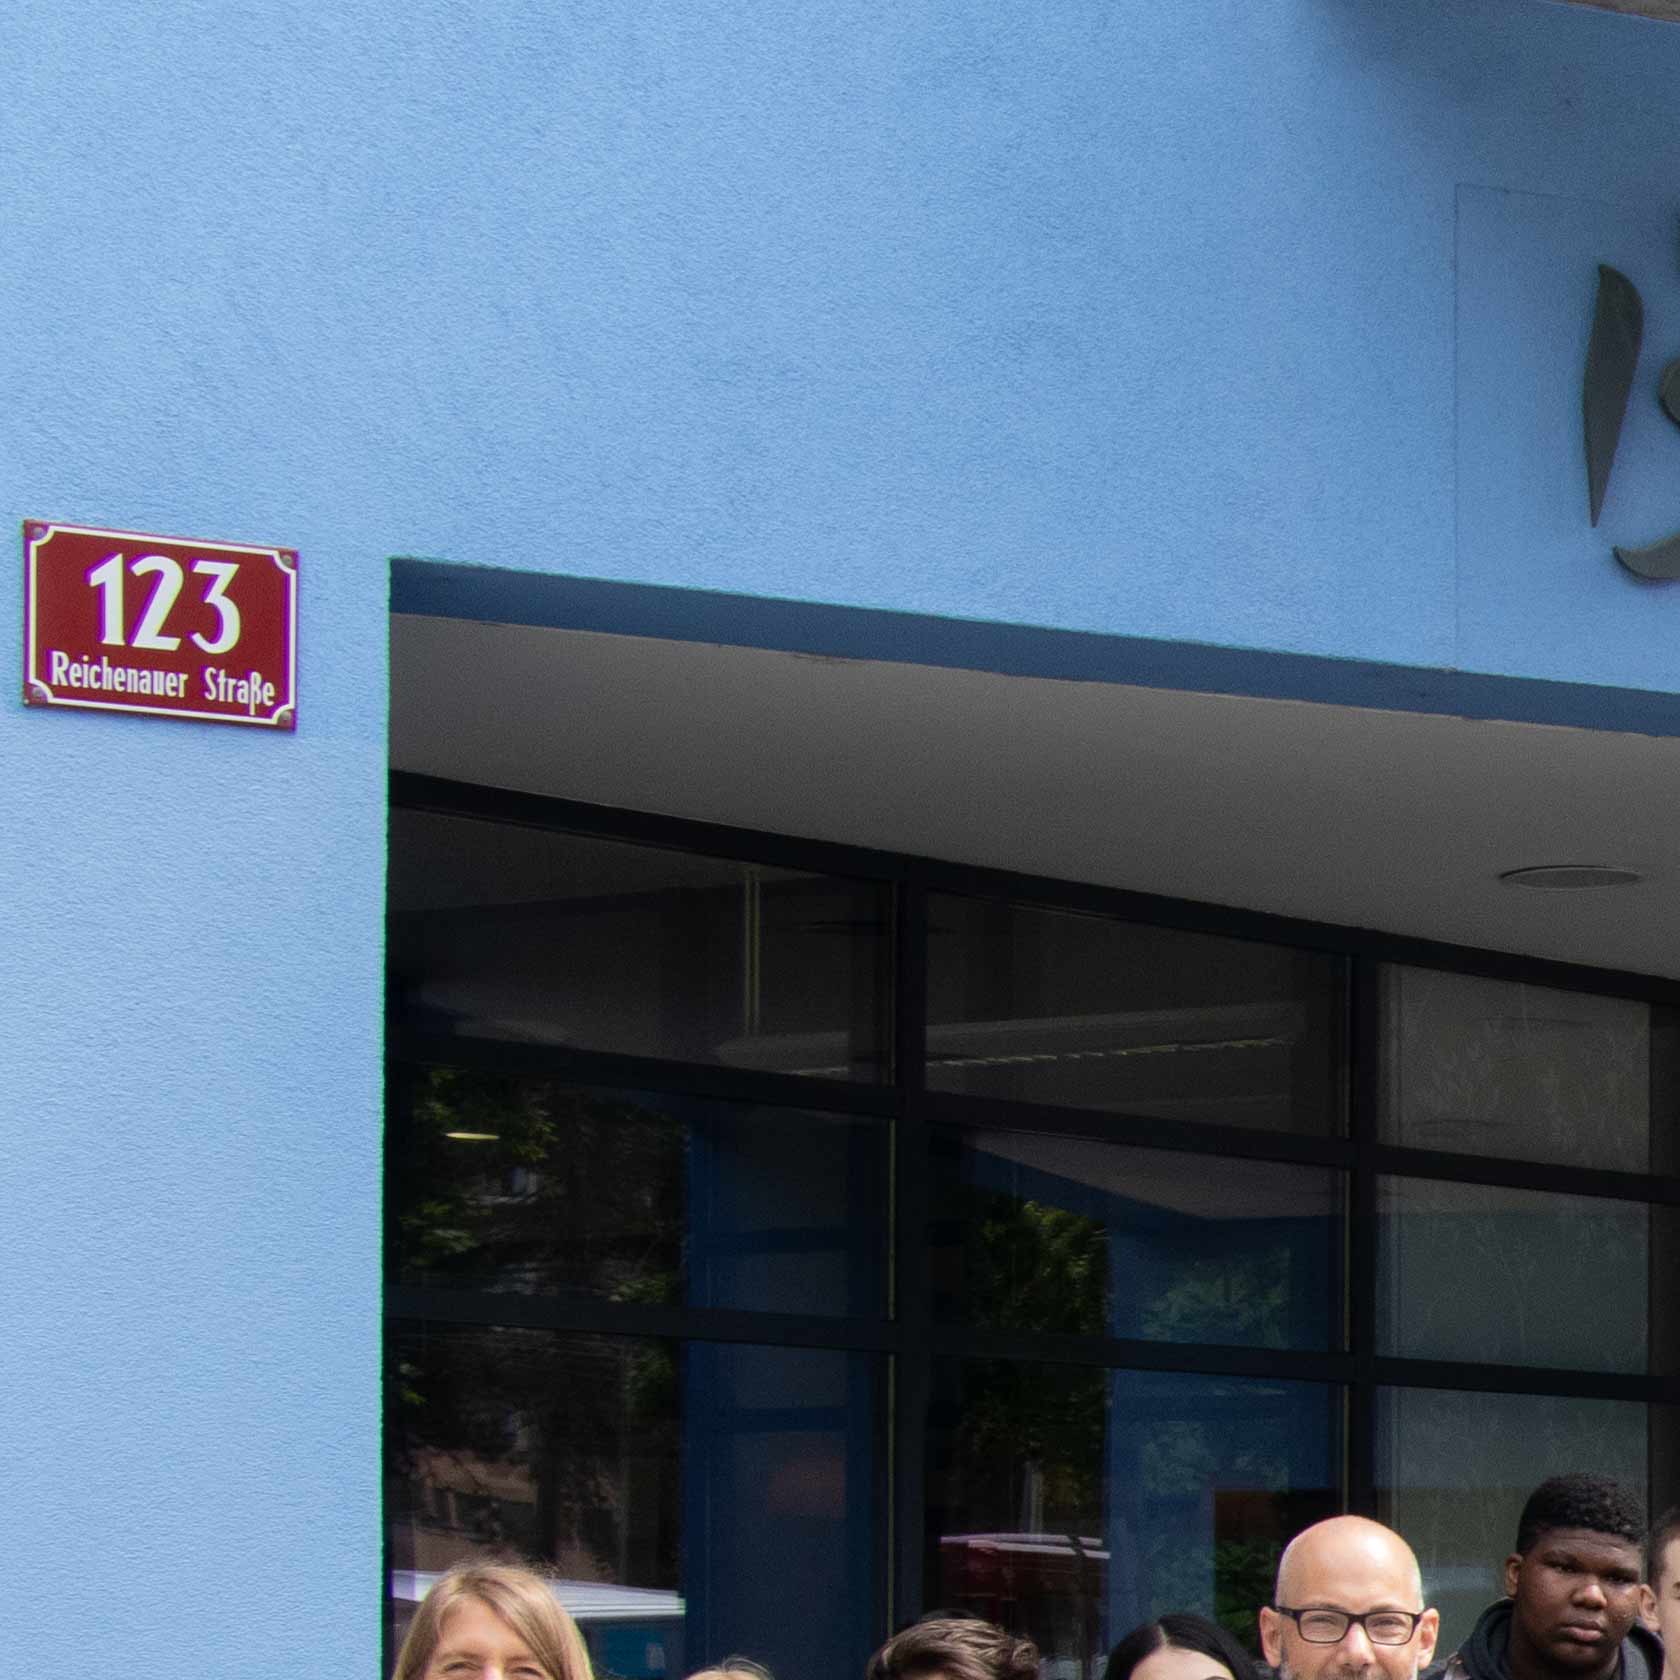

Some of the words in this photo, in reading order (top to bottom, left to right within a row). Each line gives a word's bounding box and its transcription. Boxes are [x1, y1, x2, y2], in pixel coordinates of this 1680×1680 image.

[89, 553, 241, 654] 123
[51, 650, 189, 698] Reichenauer
[204, 666, 275, 715] Straße
